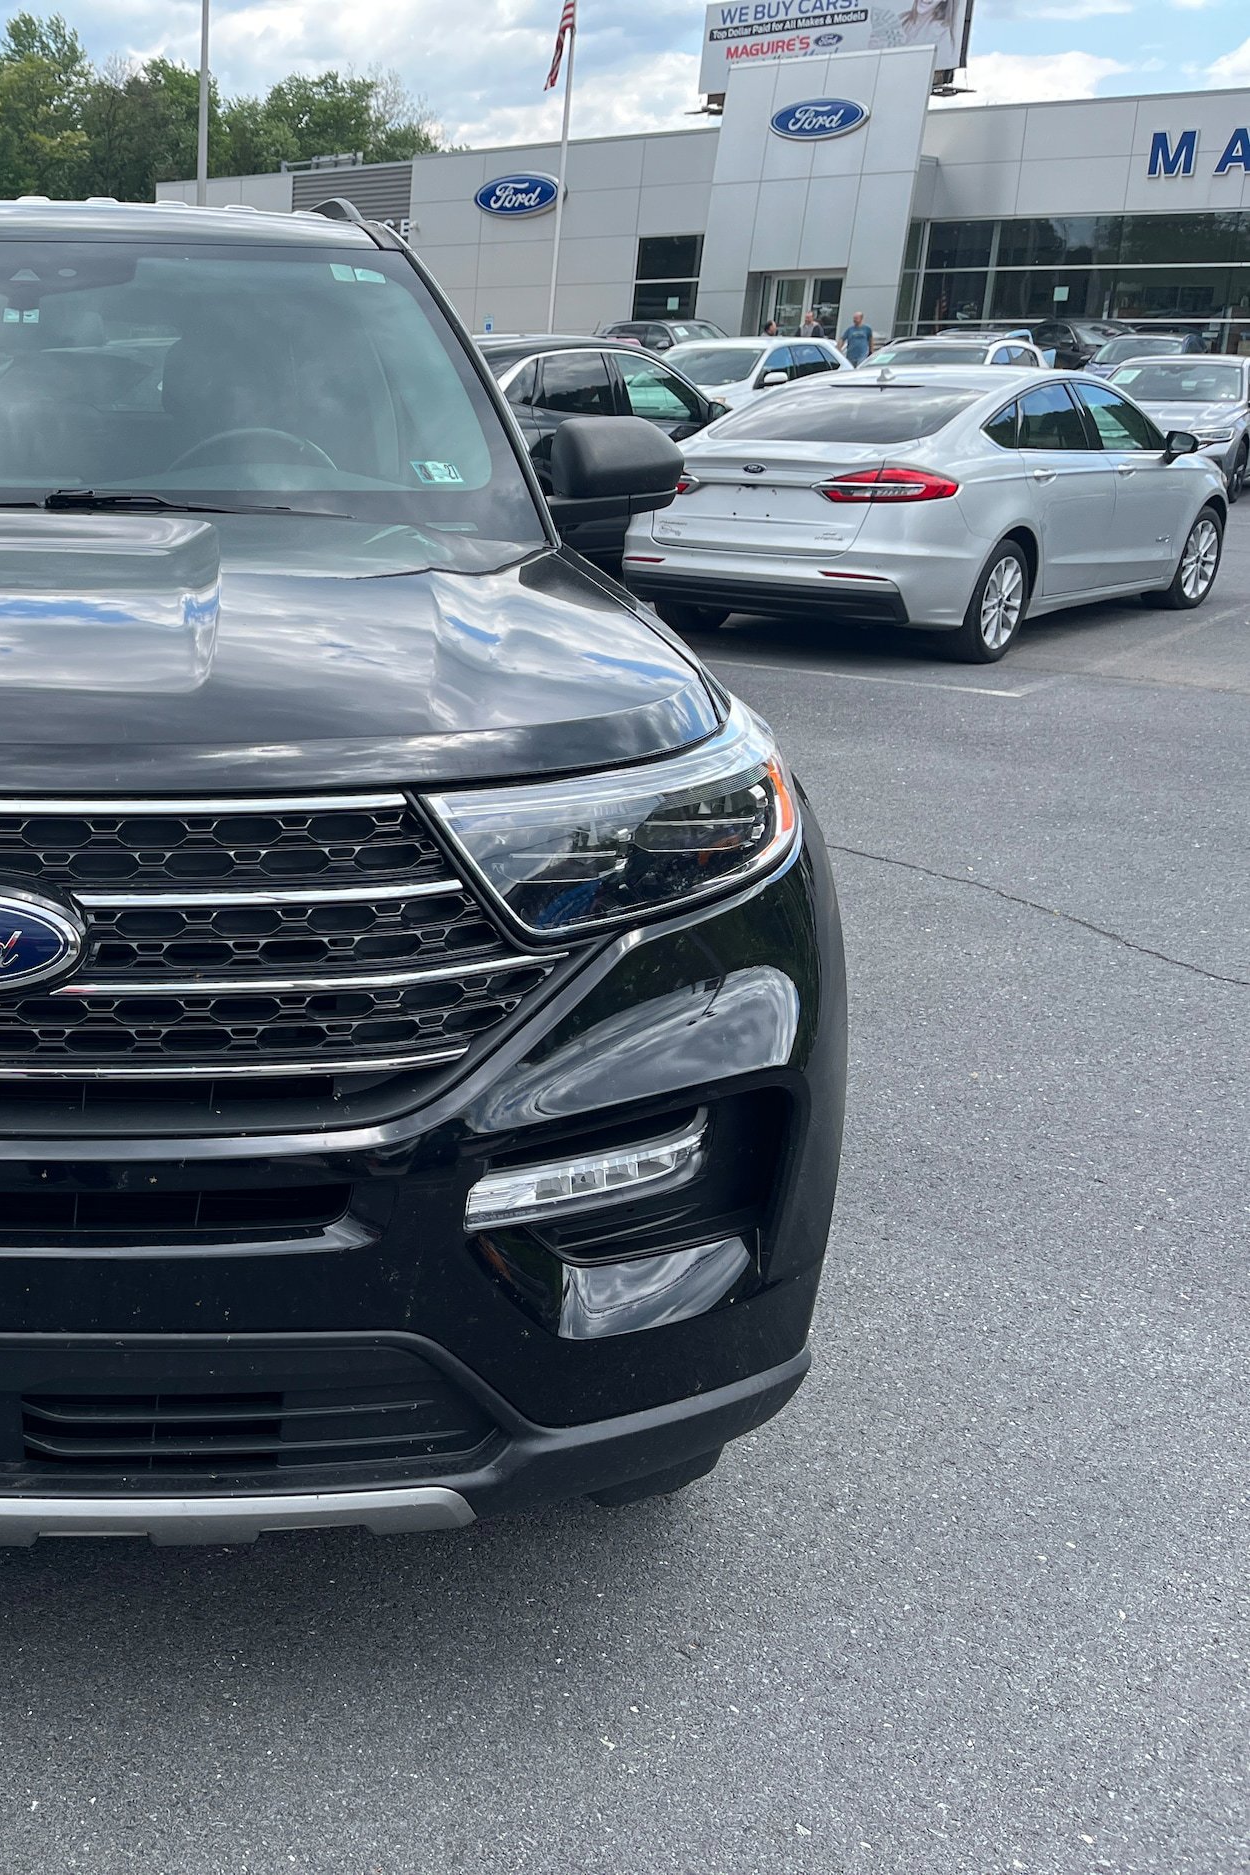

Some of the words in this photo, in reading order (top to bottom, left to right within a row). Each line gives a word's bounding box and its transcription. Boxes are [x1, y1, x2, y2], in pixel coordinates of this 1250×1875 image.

[712, 29, 727, 40] Top
[727, 26, 750, 38] Dollar
[752, 23, 771, 34] Paid
[771, 21, 783, 32] for
[784, 19, 796, 30] All
[797, 16, 824, 28] Makes
[825, 15, 832, 25] &
[833, 11, 866, 24] Models
[721, 6, 749, 25] WE
[753, 0, 794, 21] BUY
[726, 35, 810, 60] MAGUIRE'S
[788, 105, 844, 131] Ford
[490, 182, 541, 209] Ford
